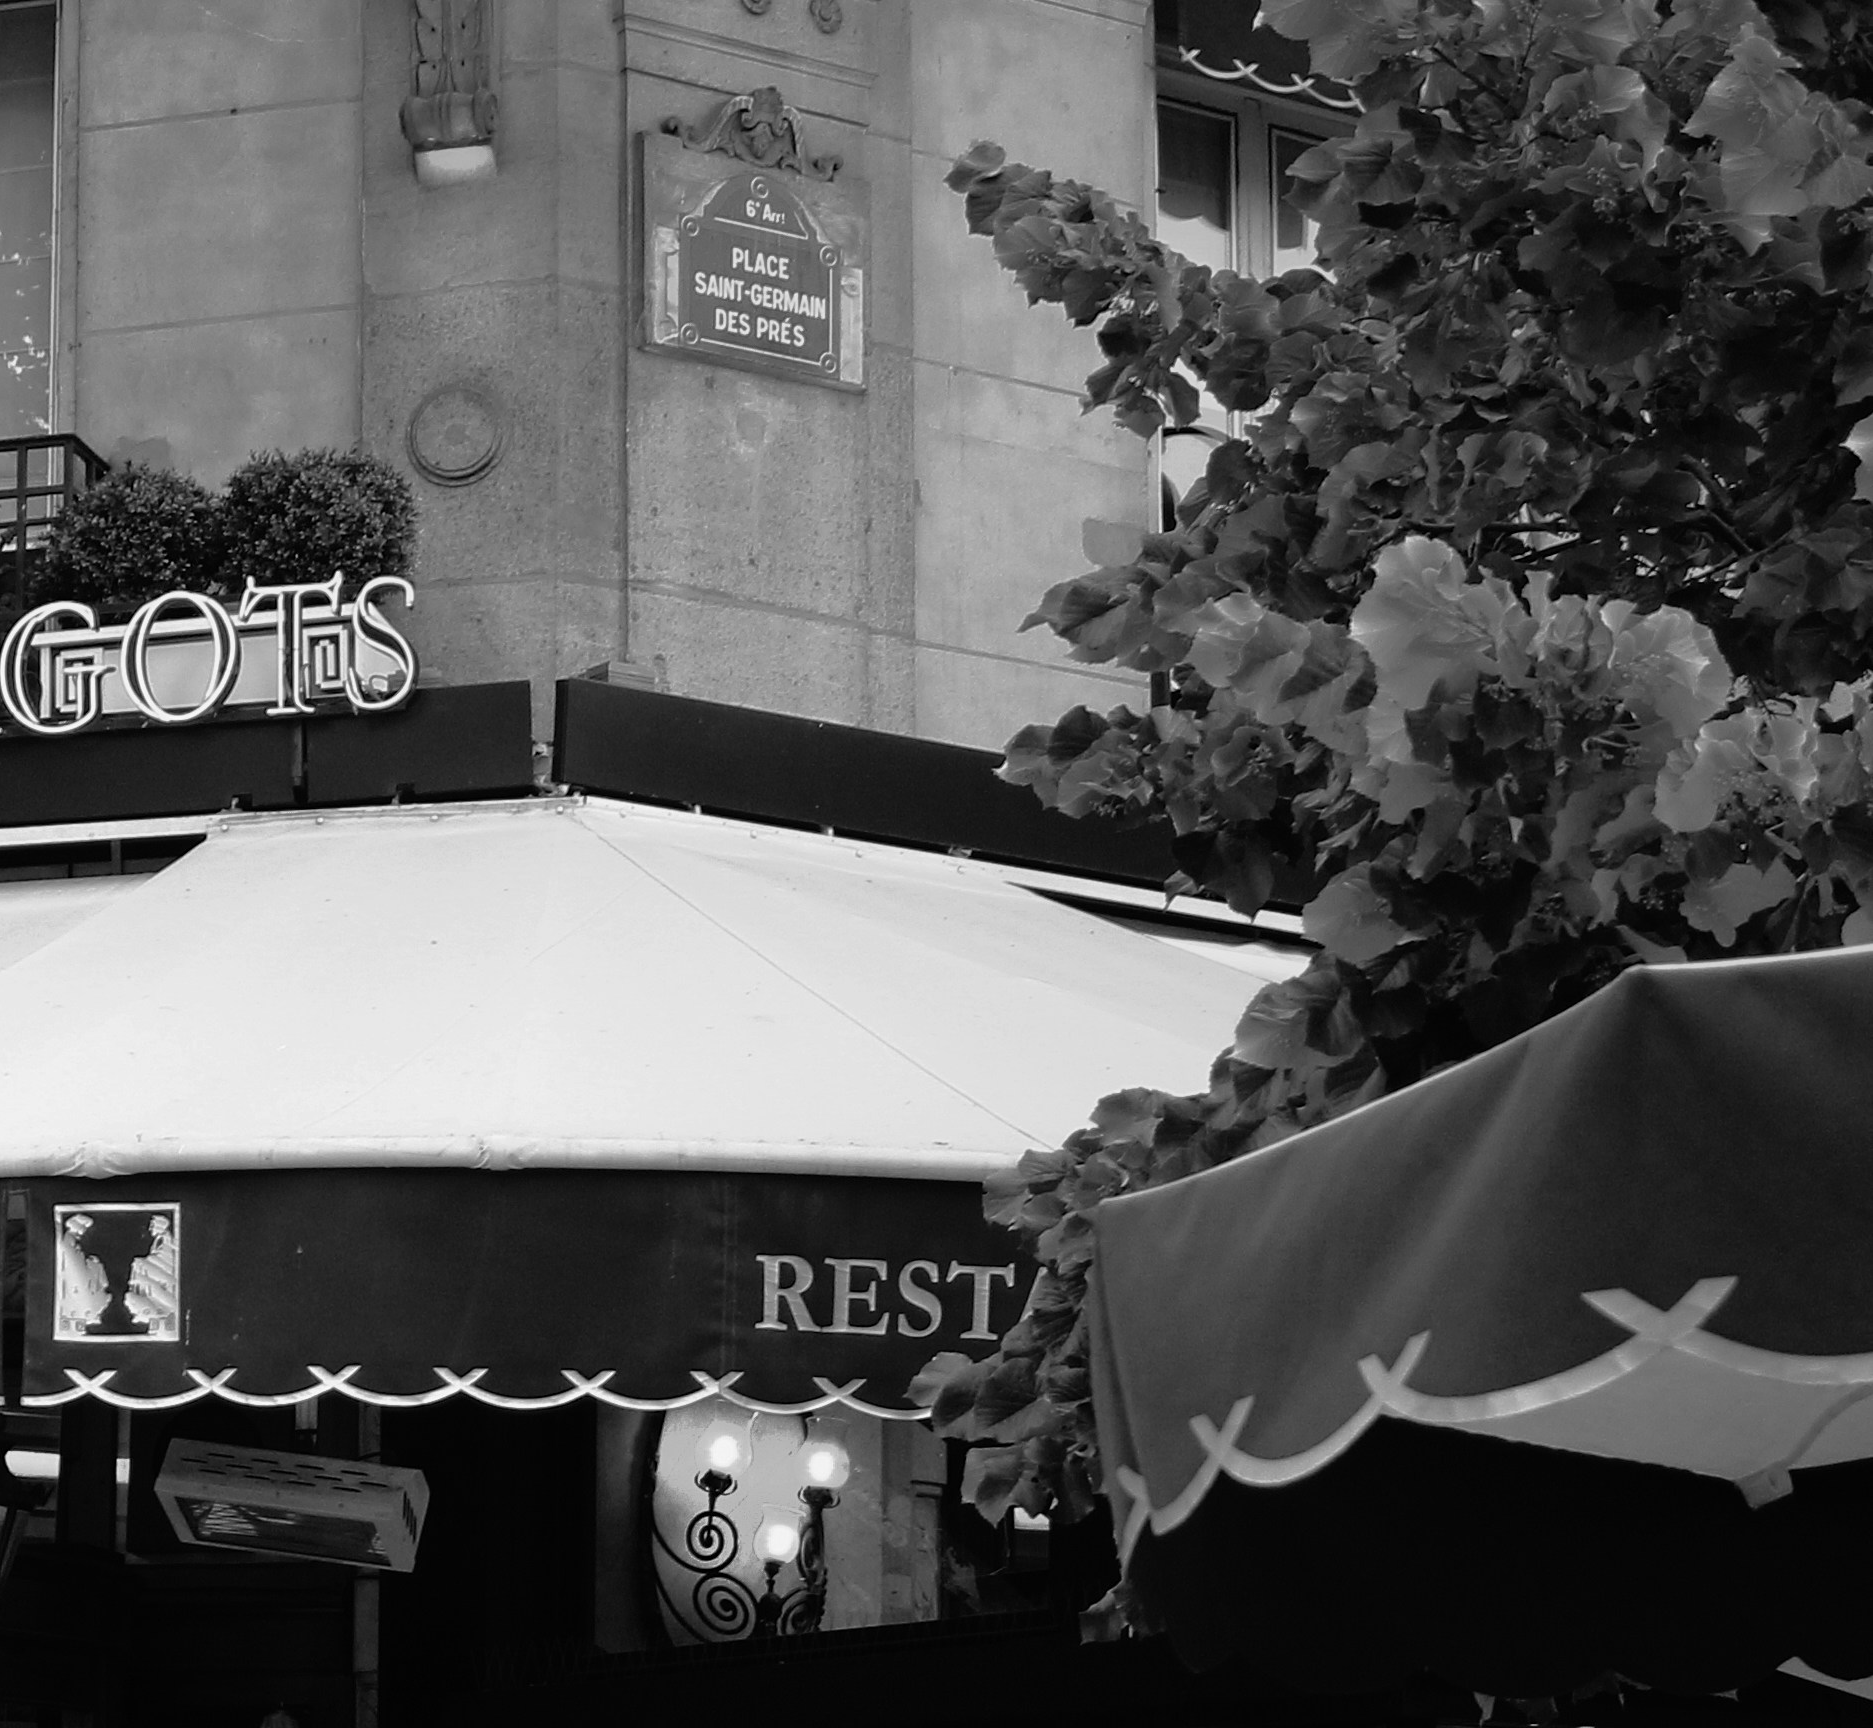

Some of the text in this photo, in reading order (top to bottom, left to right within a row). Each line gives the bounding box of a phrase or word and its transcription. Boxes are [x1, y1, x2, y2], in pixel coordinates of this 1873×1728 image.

[731, 247, 789, 280] PLACE
[694, 272, 827, 320] SAINT-GERMAIN
[714, 308, 805, 347] DES PRÉS
